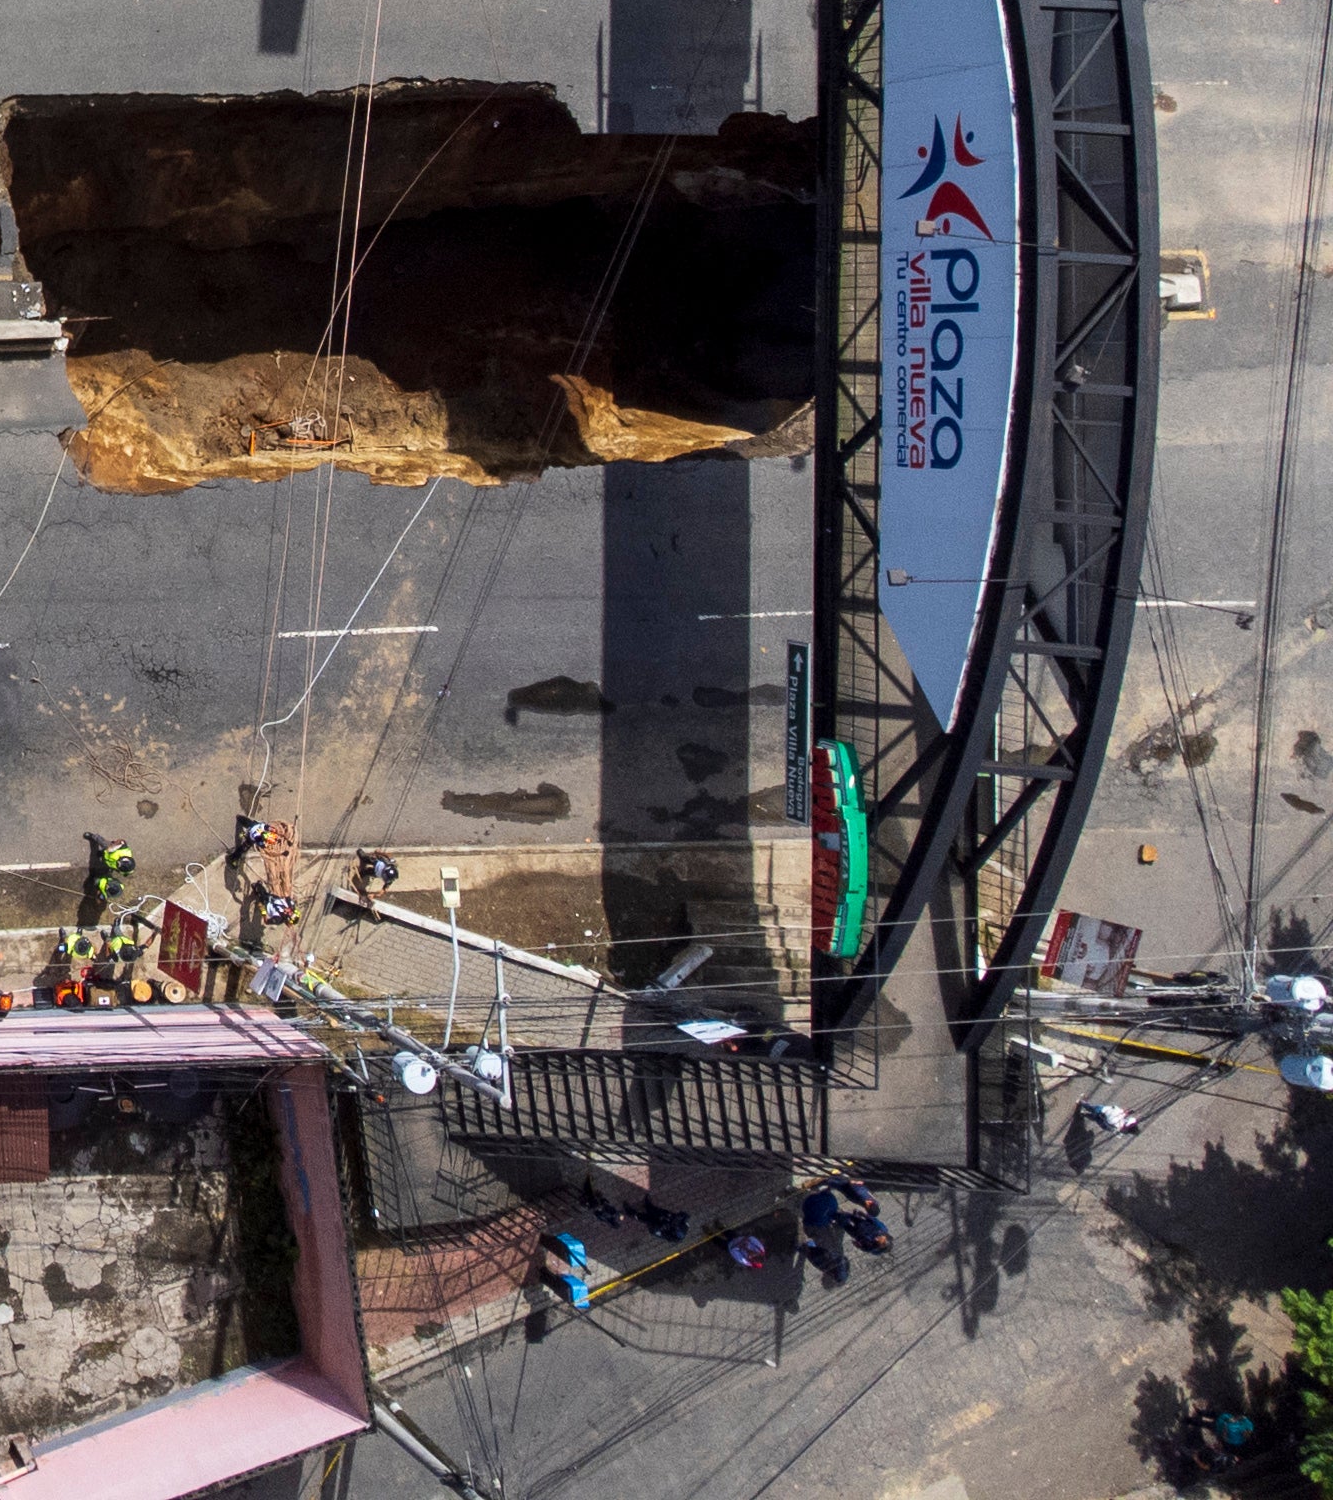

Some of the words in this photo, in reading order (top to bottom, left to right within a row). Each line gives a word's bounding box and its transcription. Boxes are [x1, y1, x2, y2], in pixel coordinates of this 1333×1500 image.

[897, 252, 909, 280] Tu
[910, 251, 932, 328] villa
[897, 290, 909, 357] centro
[897, 365, 909, 467] comercial
[910, 347, 926, 469] nueva
[787, 676, 799, 720] Plaza
[788, 725, 799, 761] Villa
[787, 766, 798, 816] Nueva
[795, 755, 806, 818] Bodegas
